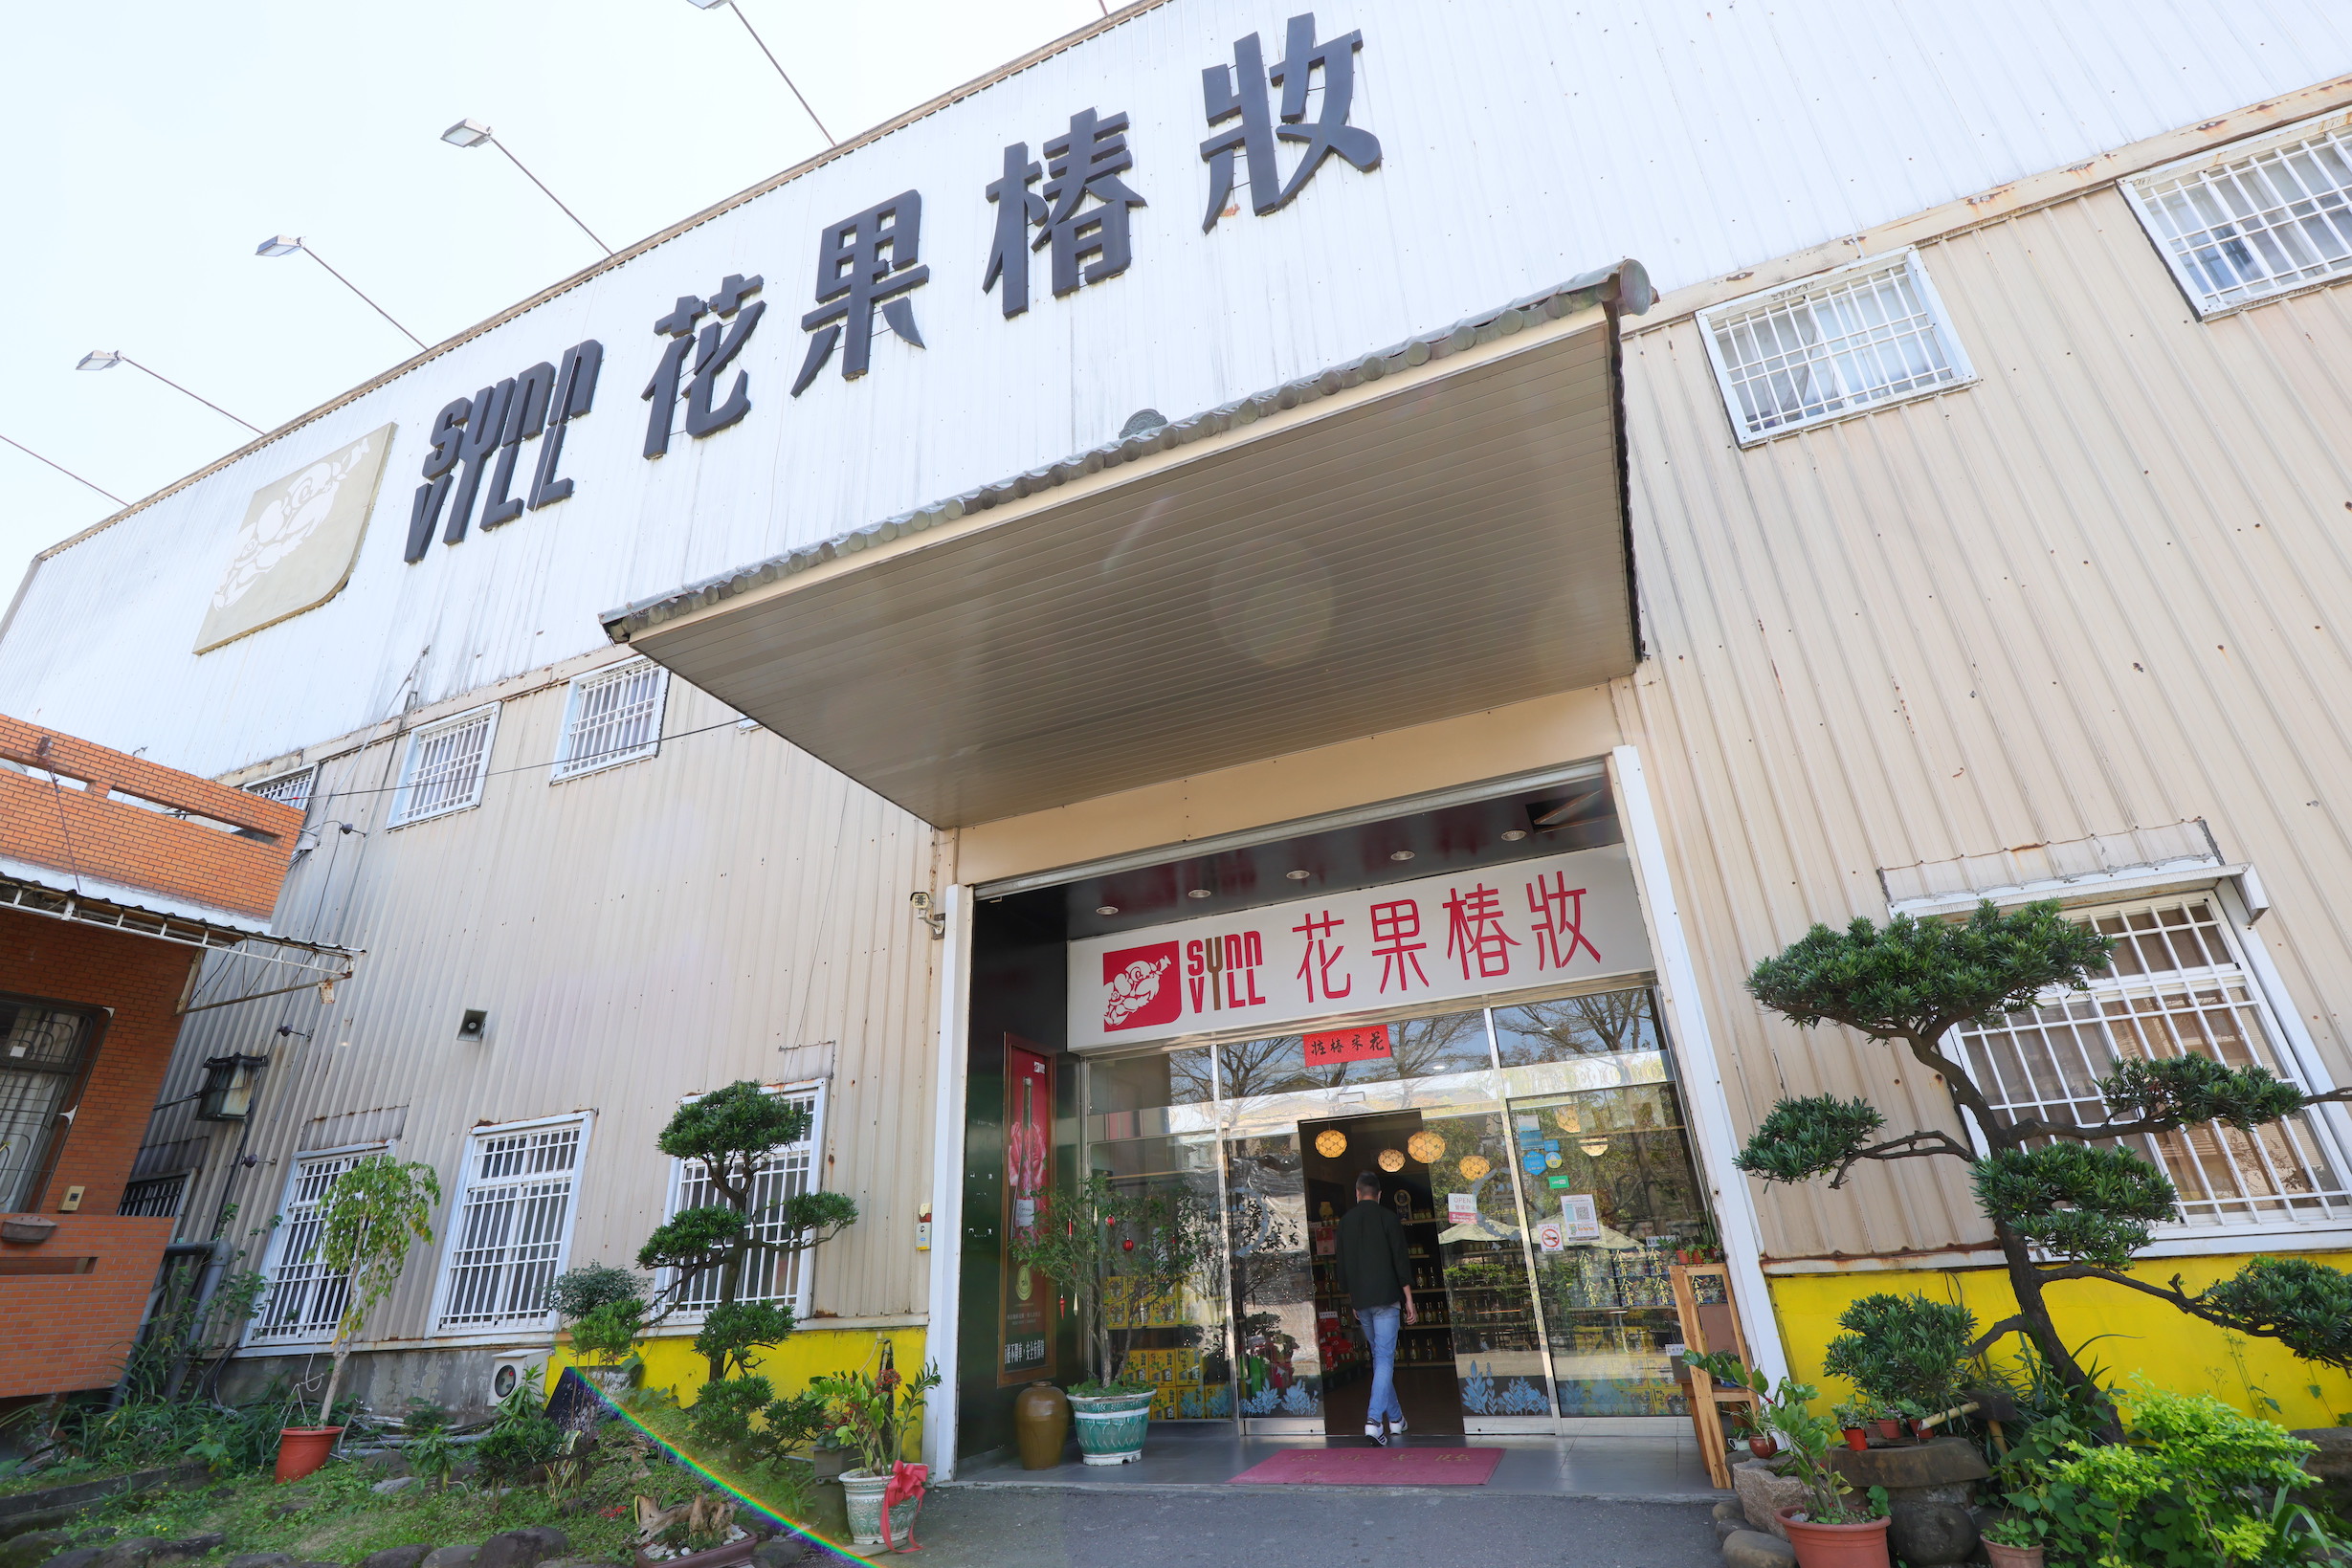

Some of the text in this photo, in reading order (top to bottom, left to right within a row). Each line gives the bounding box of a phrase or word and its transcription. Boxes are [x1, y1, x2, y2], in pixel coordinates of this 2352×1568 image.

[640, 11, 1383, 461] 花果椿妝
[1292, 870, 1603, 1005] 花果椿妝
